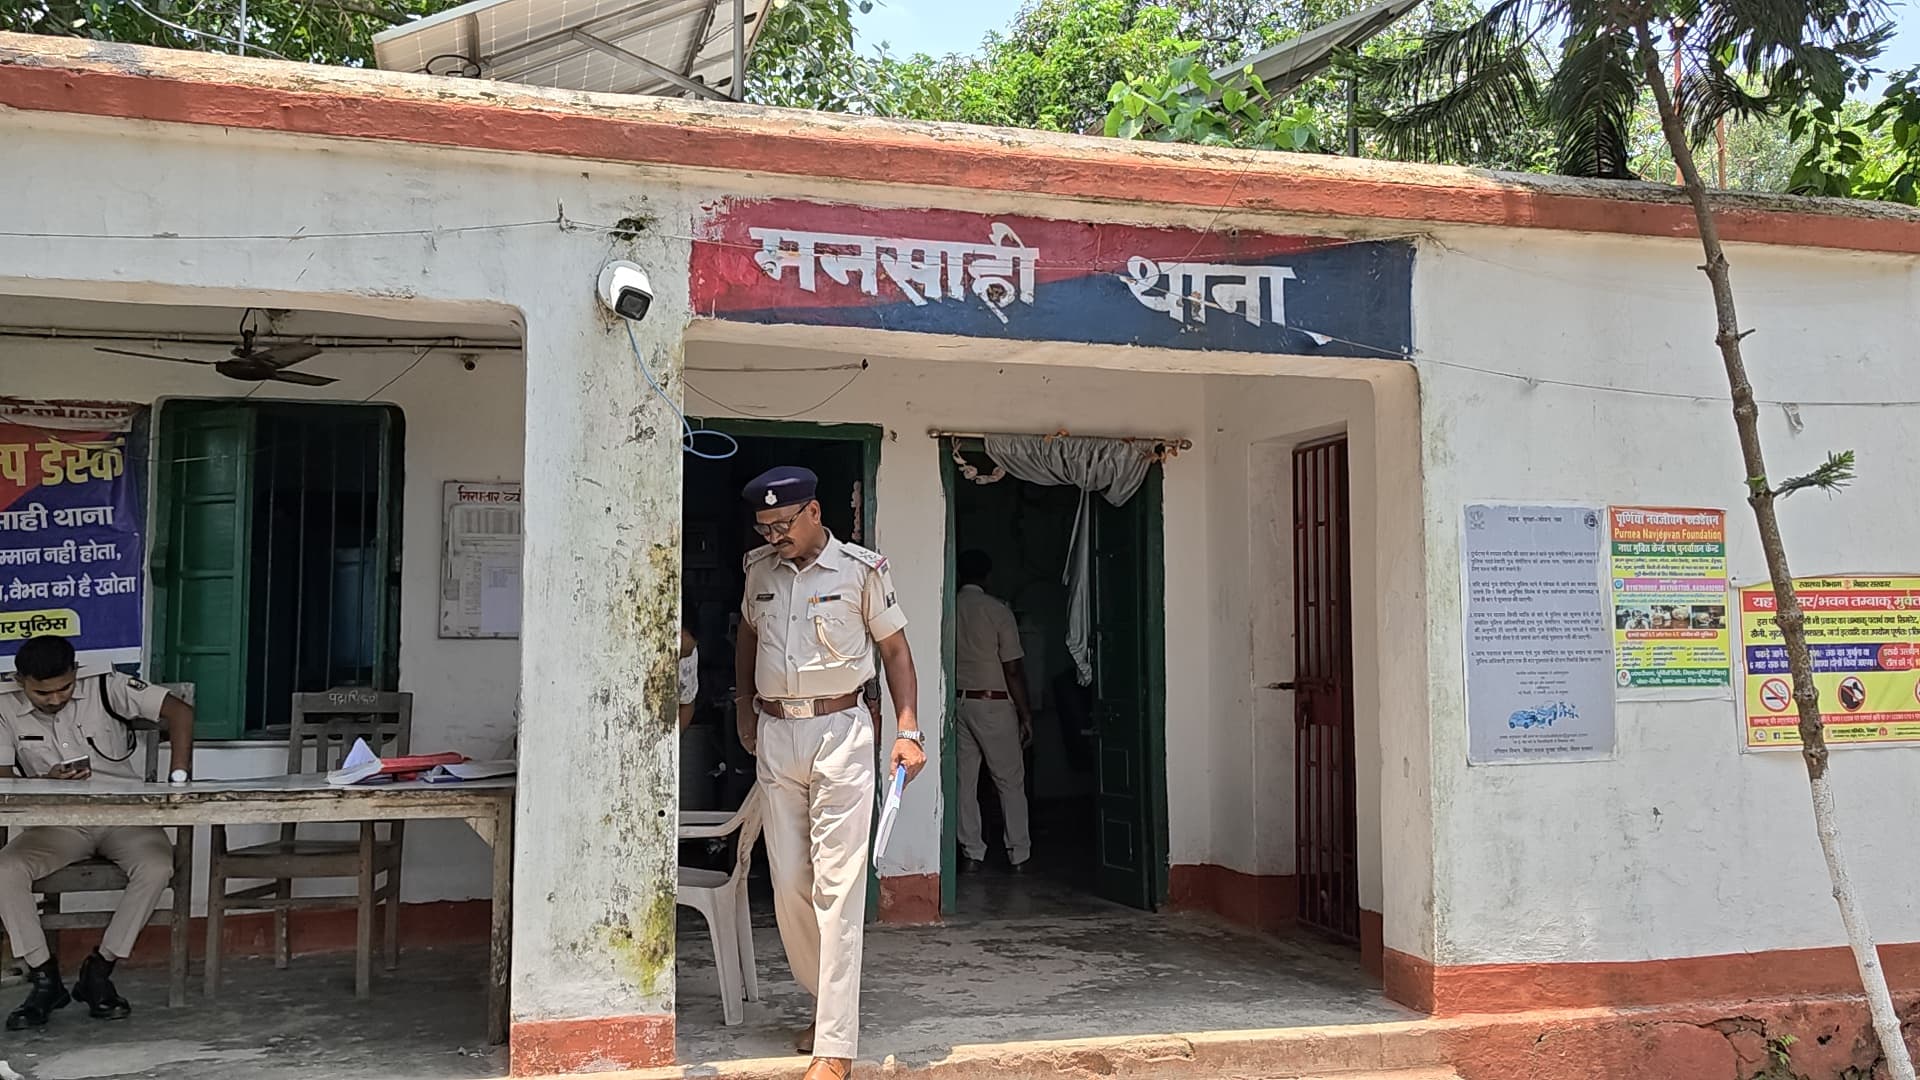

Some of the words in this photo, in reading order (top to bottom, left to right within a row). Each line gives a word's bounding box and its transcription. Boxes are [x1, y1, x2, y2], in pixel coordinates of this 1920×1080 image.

[750, 223, 1040, 324] मनसाही
[1121, 256, 1299, 326] थाना
[53, 506, 114, 527] थाना
[1614, 528, 1641, 539] Purnea
[1682, 528, 1722, 540] Foundation
[43, 539, 77, 564] नहीं
[79, 539, 121, 563] होता,
[51, 574, 76, 597] को
[78, 572, 92, 597] है
[94, 571, 137, 595] खोता
[1752, 596, 1774, 609] यह
[1851, 596, 1895, 610] तम्बाकू
[19, 614, 68, 637] पुलिस
